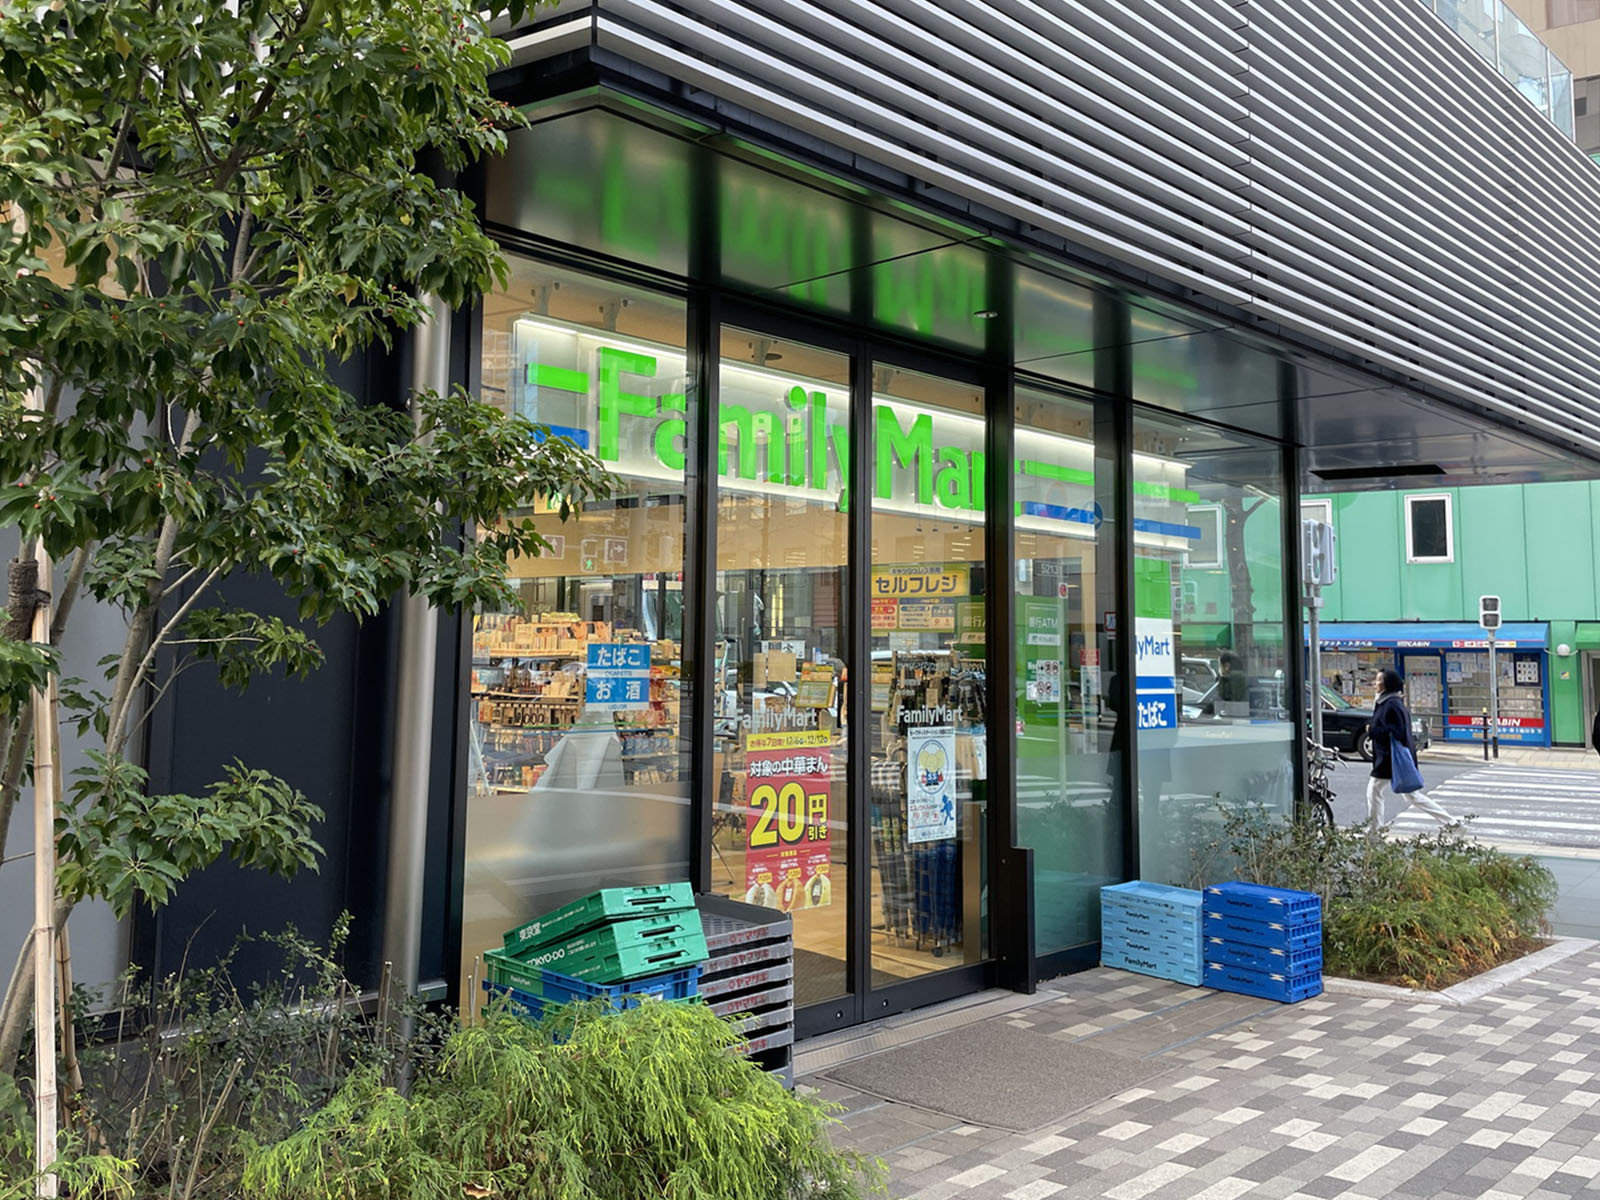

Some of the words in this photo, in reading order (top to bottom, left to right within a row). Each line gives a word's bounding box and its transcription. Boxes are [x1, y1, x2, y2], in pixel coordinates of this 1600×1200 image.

[876, 575, 957, 593] セルフレジ
[598, 647, 640, 666] たばこ
[736, 706, 816, 731] FamilyMart
[897, 704, 962, 725] FamilyMart
[1138, 700, 1167, 728] たばこ
[750, 756, 828, 777] 対象の中華まん
[750, 782, 806, 848] 20
[808, 793, 828, 825] 円
[808, 825, 828, 841] 引き
[1124, 956, 1157, 970] FamilyMart
